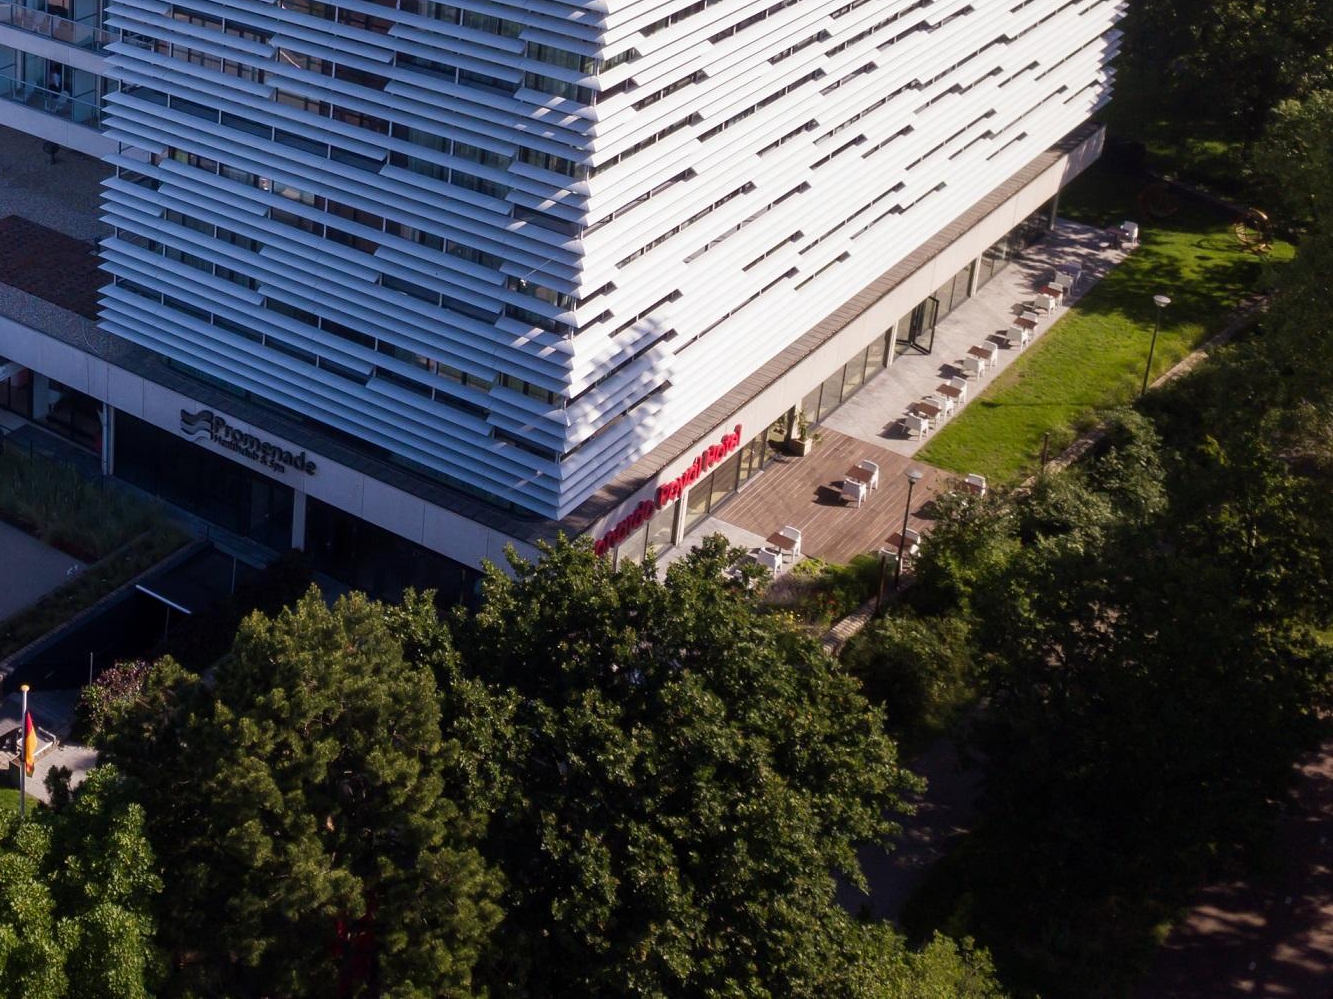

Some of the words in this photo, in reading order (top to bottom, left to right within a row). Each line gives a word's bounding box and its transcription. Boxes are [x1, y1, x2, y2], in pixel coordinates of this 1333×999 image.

[214, 415, 317, 476] Promenade
[654, 456, 703, 510] Royal
[702, 424, 742, 473] Hotel
